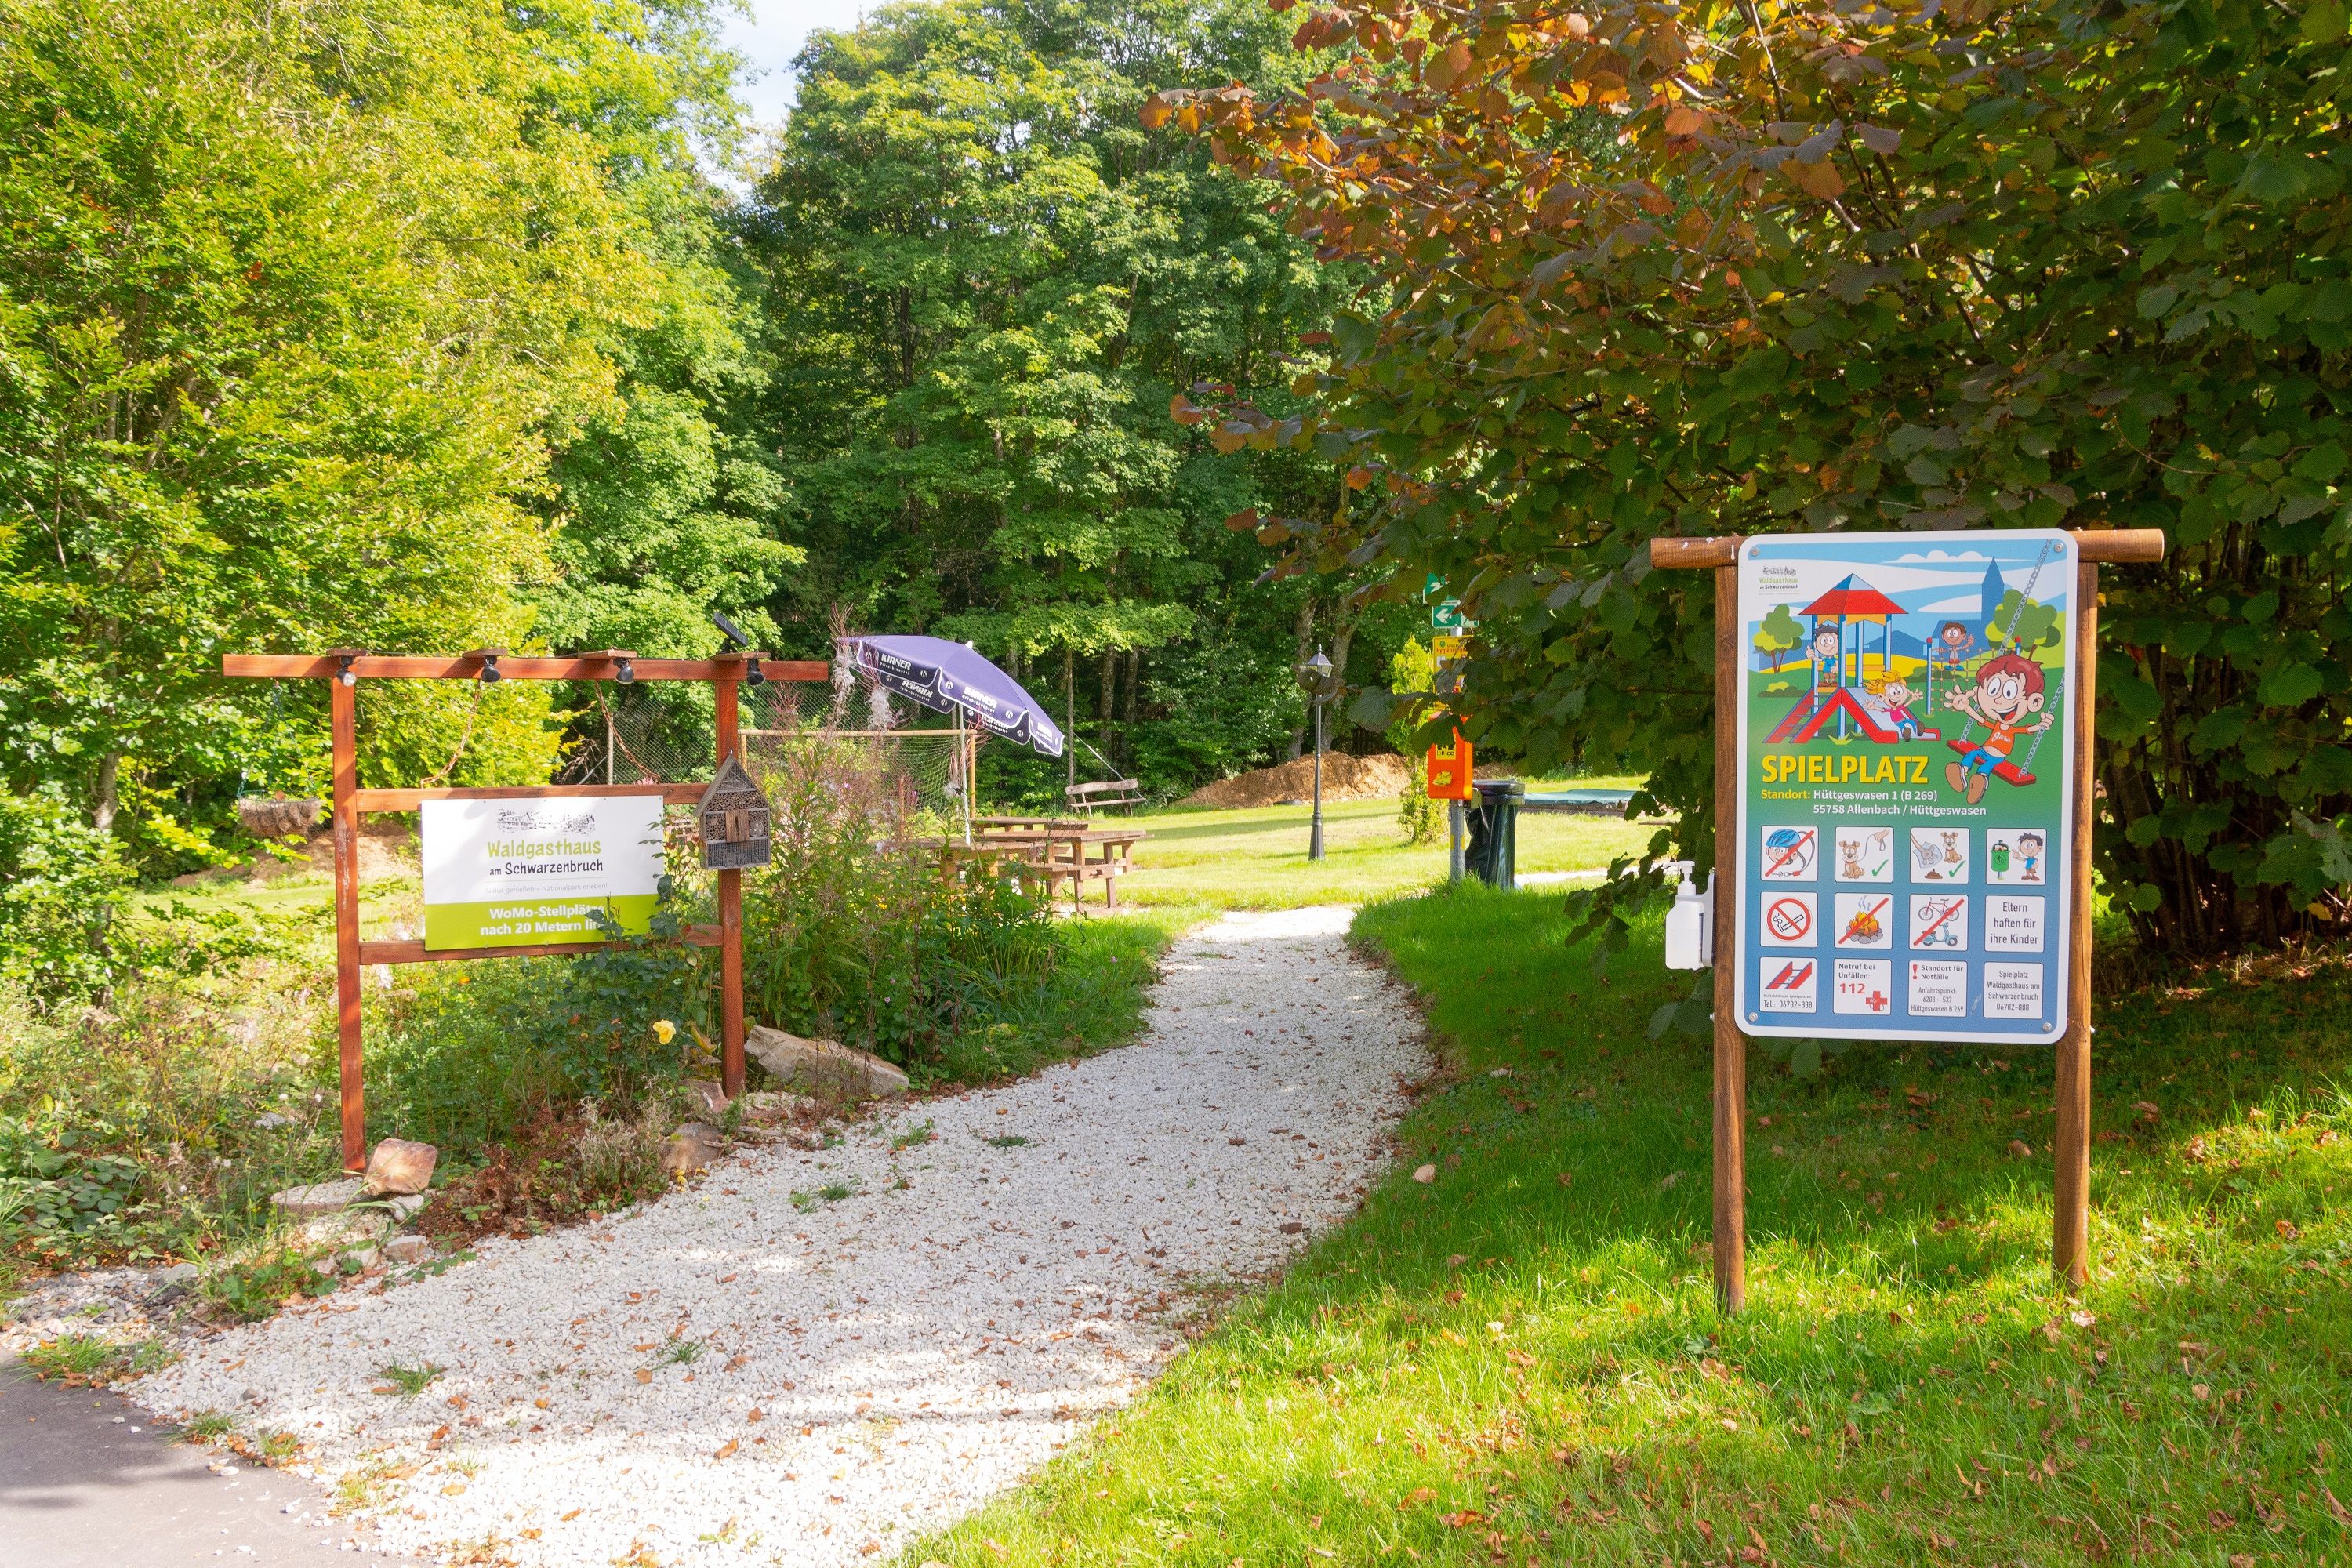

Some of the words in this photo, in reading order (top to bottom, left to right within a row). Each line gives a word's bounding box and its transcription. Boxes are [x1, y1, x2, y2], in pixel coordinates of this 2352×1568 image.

[881, 653, 911, 670] KIRNER
[1762, 754, 1929, 783] SPIELPLATZ
[1761, 789, 1811, 800] Standort:
[1813, 789, 1889, 802] Hüttgeswasen
[1892, 791, 1898, 800] 1
[1900, 790, 1911, 802] (B
[1915, 790, 1938, 802] 269)
[1813, 804, 1845, 815] 55758
[1847, 804, 1900, 815] Allenbach
[1910, 805, 1987, 818] Hüttgeswasen
[487, 839, 602, 859] Waldgasthaus
[505, 859, 603, 875] Schwarzenbruch
[505, 885, 535, 895] genießen
[542, 884, 581, 893] Nationalpark
[583, 882, 608, 891] erleben!
[2002, 902, 2027, 913] Eltern
[481, 923, 511, 935] nach
[515, 923, 532, 935] 20
[535, 921, 582, 933] Metern
[1994, 917, 2020, 928] haften
[2024, 918, 2036, 928] für
[1991, 933, 2007, 943] ihre
[2010, 934, 2038, 945] Kinder
[1999, 970, 2028, 979] Spielplatz
[1839, 982, 1866, 994] 112
[1987, 981, 2029, 990] Waldgasthaus
[1988, 992, 2038, 1000] Schwarzenbruch
[1779, 1000, 1813, 1009] 06782-888
